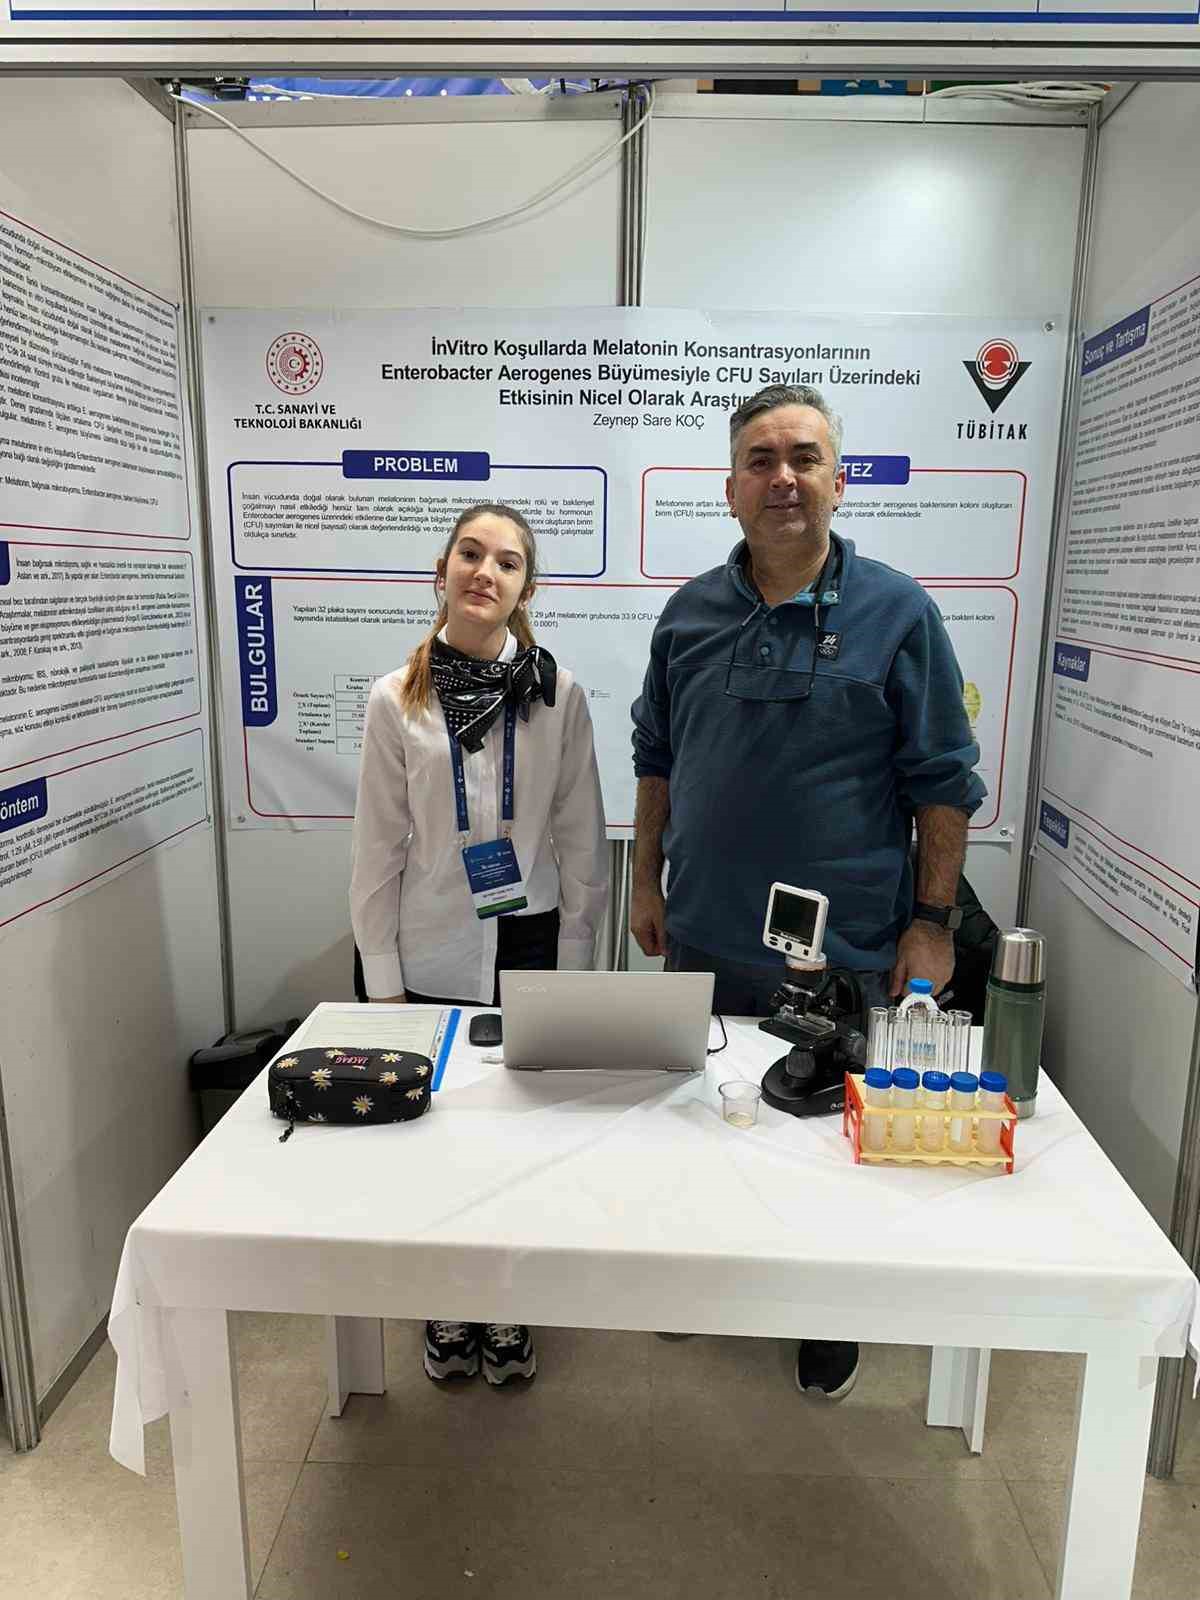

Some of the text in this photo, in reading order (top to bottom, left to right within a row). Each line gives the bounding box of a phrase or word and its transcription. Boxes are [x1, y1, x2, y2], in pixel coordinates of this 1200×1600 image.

[432, 336, 870, 363] İnVitro Koşullarda Melatonin Konsantrasyonlarının
[382, 364, 921, 386] Enterobacter Aerogenes Büyümesiyle CFU Sayıları Üzerindeki
[256, 402, 337, 415] T.C. SANAYİ VE
[500, 389, 752, 411] Etkisinin Nicel Olarak Araştır
[234, 416, 362, 430] TEKNOLOJİ BAKANLIĞI
[593, 413, 705, 430] Zeynep Sare KOÇ
[956, 419, 1028, 440] TÜBİTAK
[374, 457, 459, 473] PROBLEM
[245, 584, 268, 713] BULGULAR
[0, 795, 39, 820] öntem
